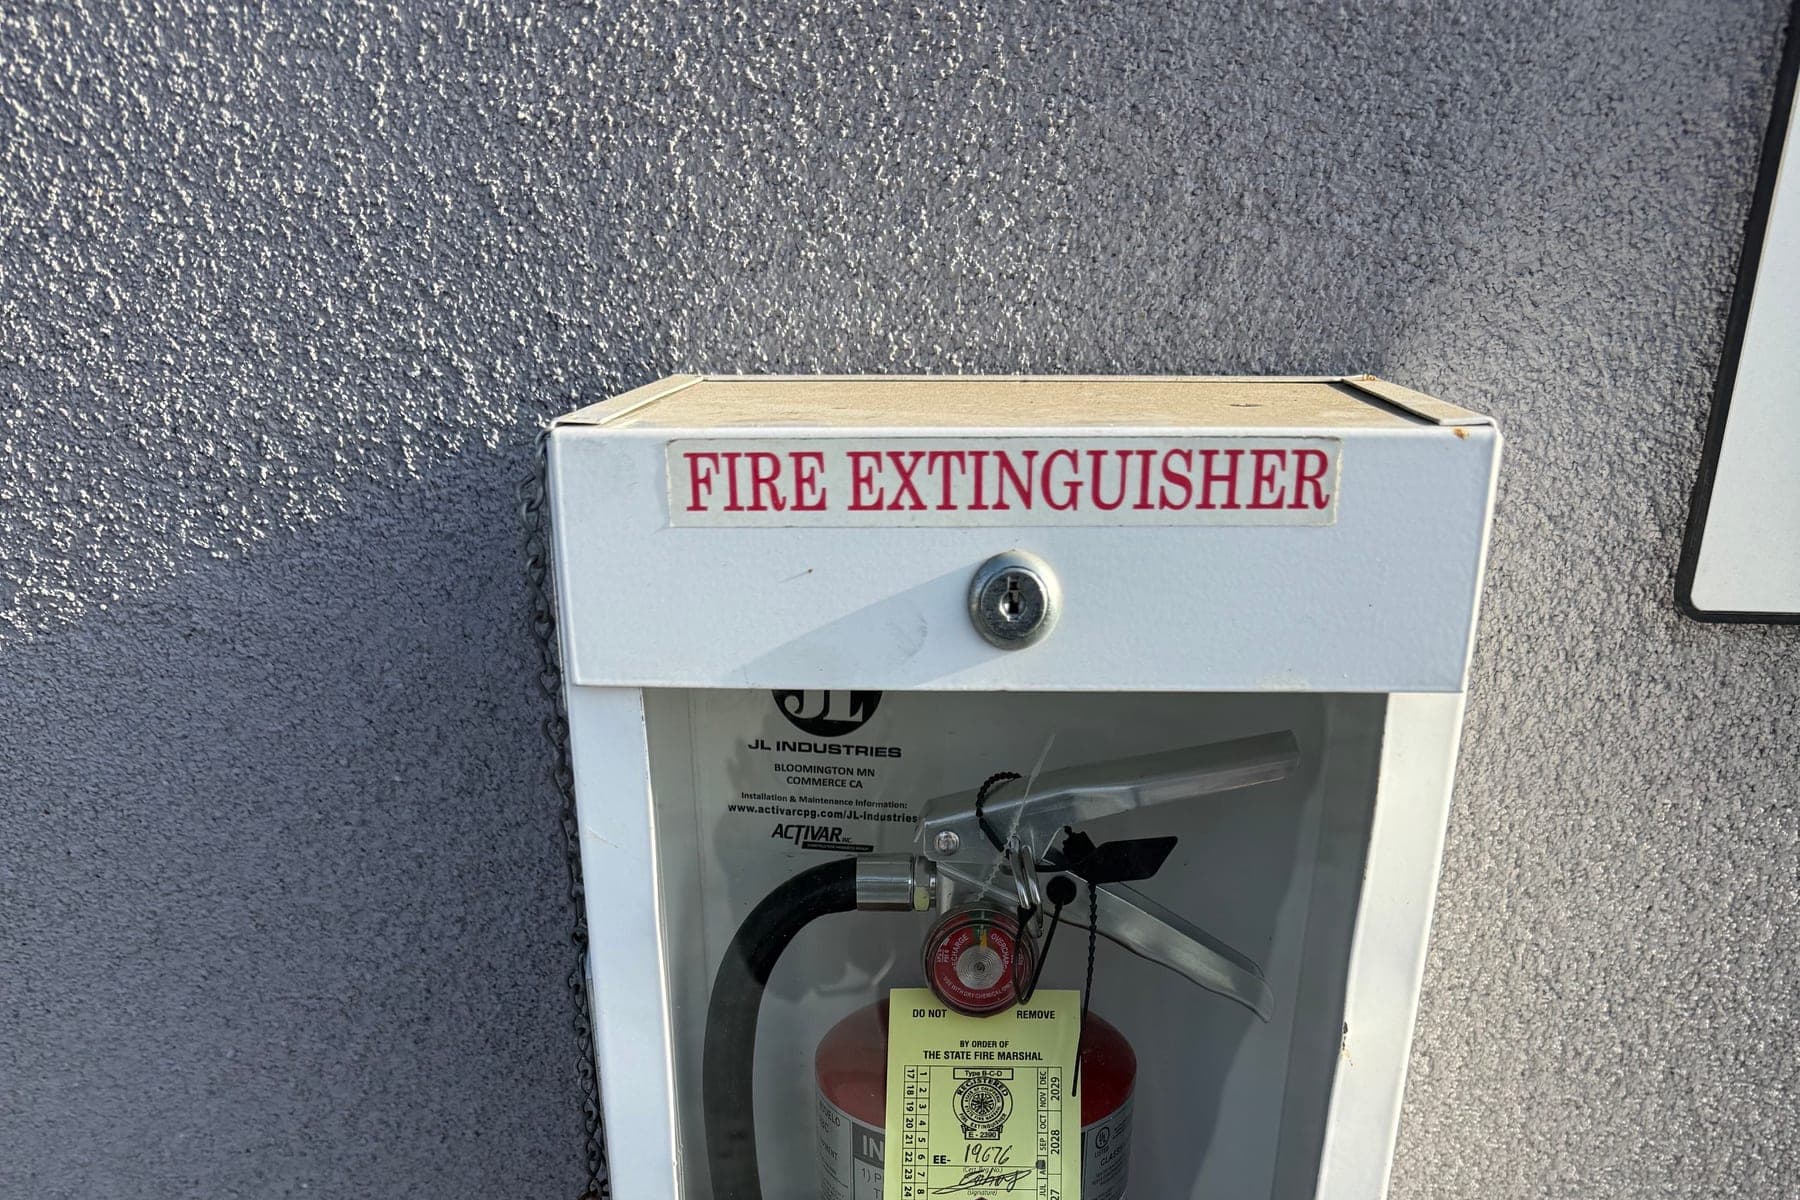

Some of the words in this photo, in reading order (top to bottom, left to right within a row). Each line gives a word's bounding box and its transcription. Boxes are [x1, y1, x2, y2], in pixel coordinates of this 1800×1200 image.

[684, 451, 827, 512] FIRE
[847, 448, 1331, 512] EXTINGUISHER
[748, 739, 772, 751] JL
[776, 741, 902, 758] INDUSTRIES
[774, 763, 854, 776] BLOOMINGTON
[857, 767, 875, 777] MN
[787, 775, 847, 788] COMMERCE
[849, 778, 863, 789] CA
[741, 791, 788, 802] Installation
[789, 795, 797, 803] &
[799, 795, 853, 807] Maintenance
[771, 823, 843, 844] ACTIVAR
[912, 1009, 926, 1018] DO
[928, 1009, 947, 1018] NOT
[1016, 1010, 1056, 1019] REMOVE
[959, 1040, 970, 1048] BY
[971, 1040, 998, 1048] ORDER
[999, 1040, 1010, 1048] OF
[923, 1050, 941, 1059] THE
[943, 1050, 972, 1060] STATE
[974, 1050, 995, 1060] FIRE
[997, 1051, 1043, 1061] MARSHAL
[906, 1069, 914, 1079] 17
[964, 1070, 980, 1078] Type
[906, 1085, 914, 1095] 18
[956, 1077, 1009, 1097] REGISTERED
[1051, 1076, 1060, 1101] 2029
[906, 1102, 914, 1111] 19
[906, 1117, 913, 1128] 20
[905, 1134, 913, 1144] 21
[1050, 1130, 1060, 1155] 2028
[905, 1151, 912, 1162] 22
[933, 1154, 951, 1164] EE-
[904, 1169, 912, 1180] 23
[904, 1186, 912, 1197] 24
